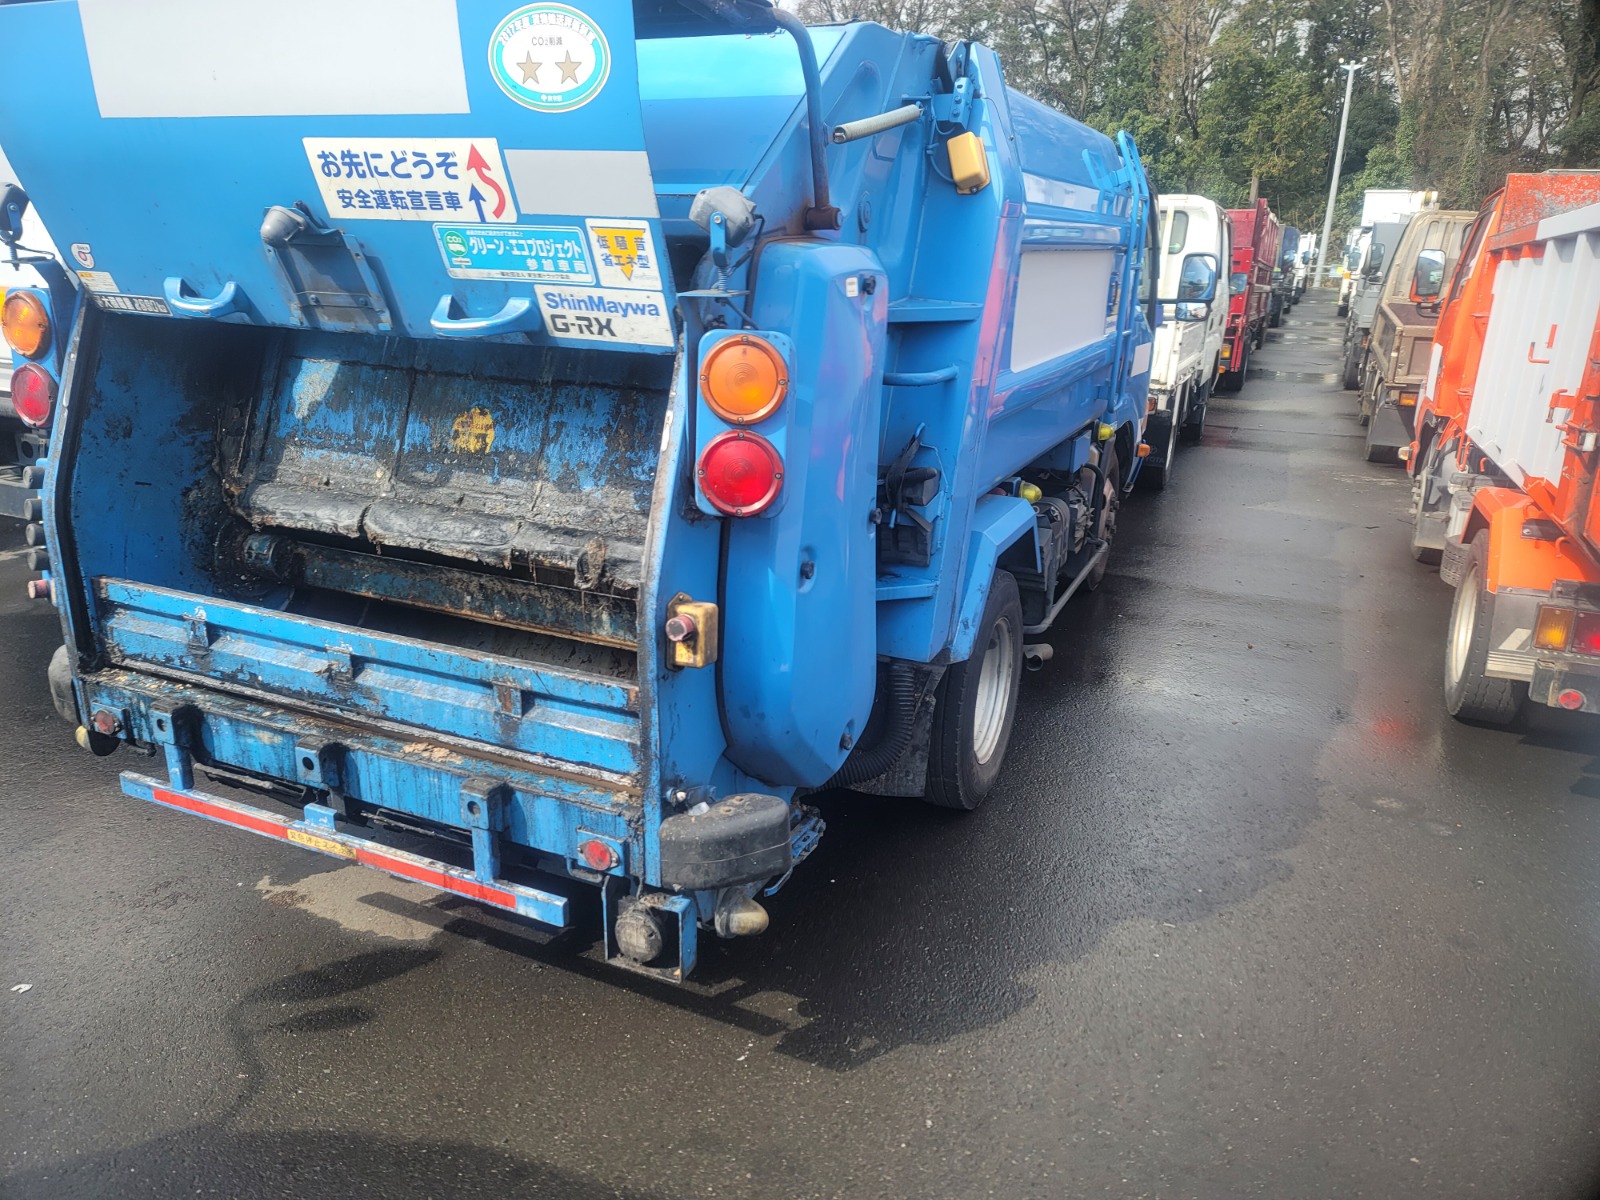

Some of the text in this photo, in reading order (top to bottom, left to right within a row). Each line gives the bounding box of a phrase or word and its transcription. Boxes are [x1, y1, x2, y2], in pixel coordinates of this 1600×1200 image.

[317, 149, 460, 180] お先にどうぞ
[337, 188, 463, 212] 安全運転宣言車
[469, 237, 583, 259] グリーン・エコプロジェクト
[600, 252, 651, 269] 省エネ型
[544, 290, 661, 318] ShinMaywa
[550, 313, 618, 338] G-RX
